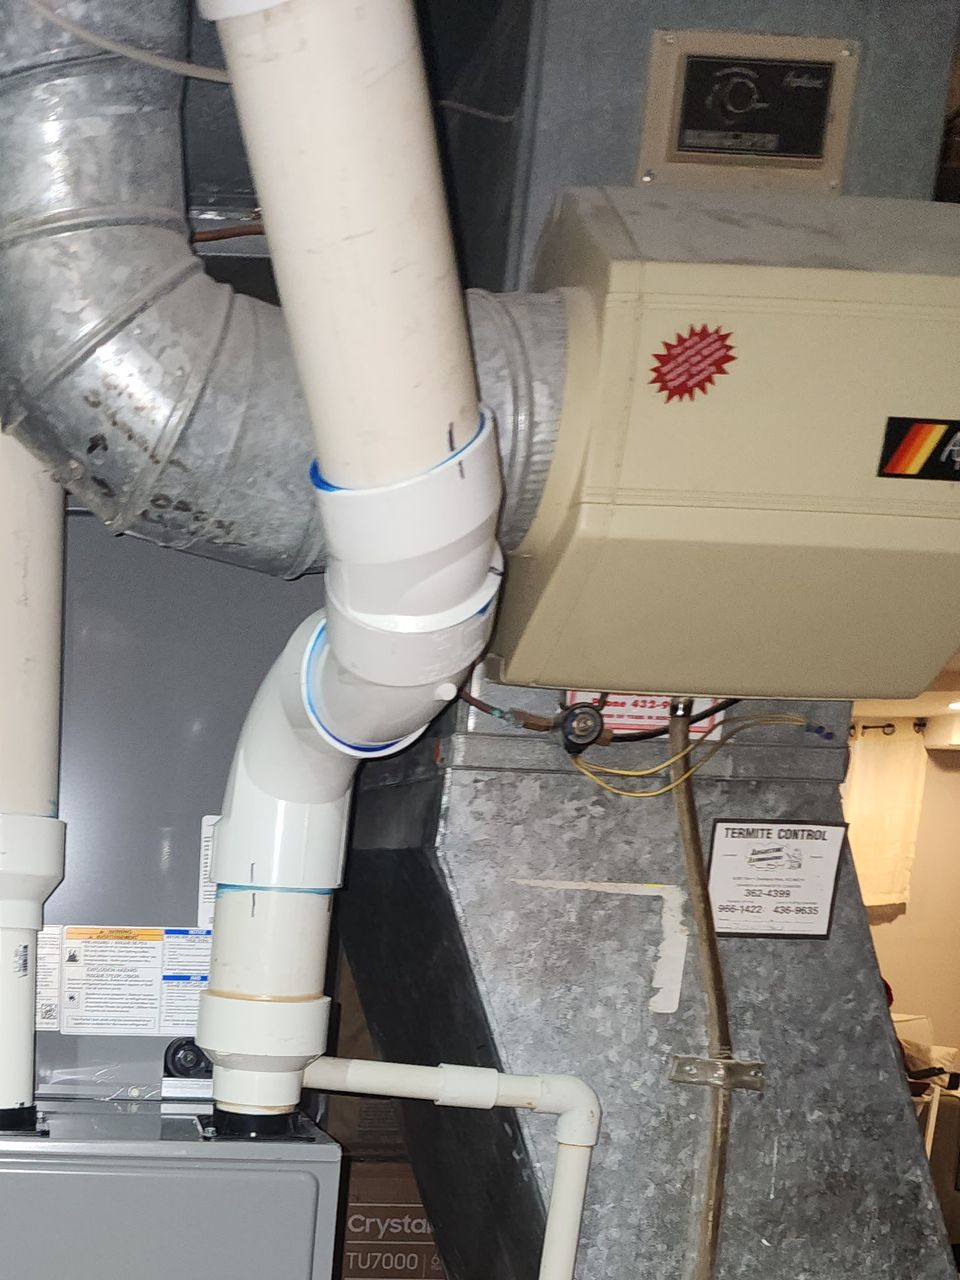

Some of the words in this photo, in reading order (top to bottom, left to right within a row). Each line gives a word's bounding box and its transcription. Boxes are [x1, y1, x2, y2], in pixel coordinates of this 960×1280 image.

[724, 827, 773, 840] TERMITE
[777, 828, 828, 841] CONTROL
[346, 1252, 418, 1270] TU7000
